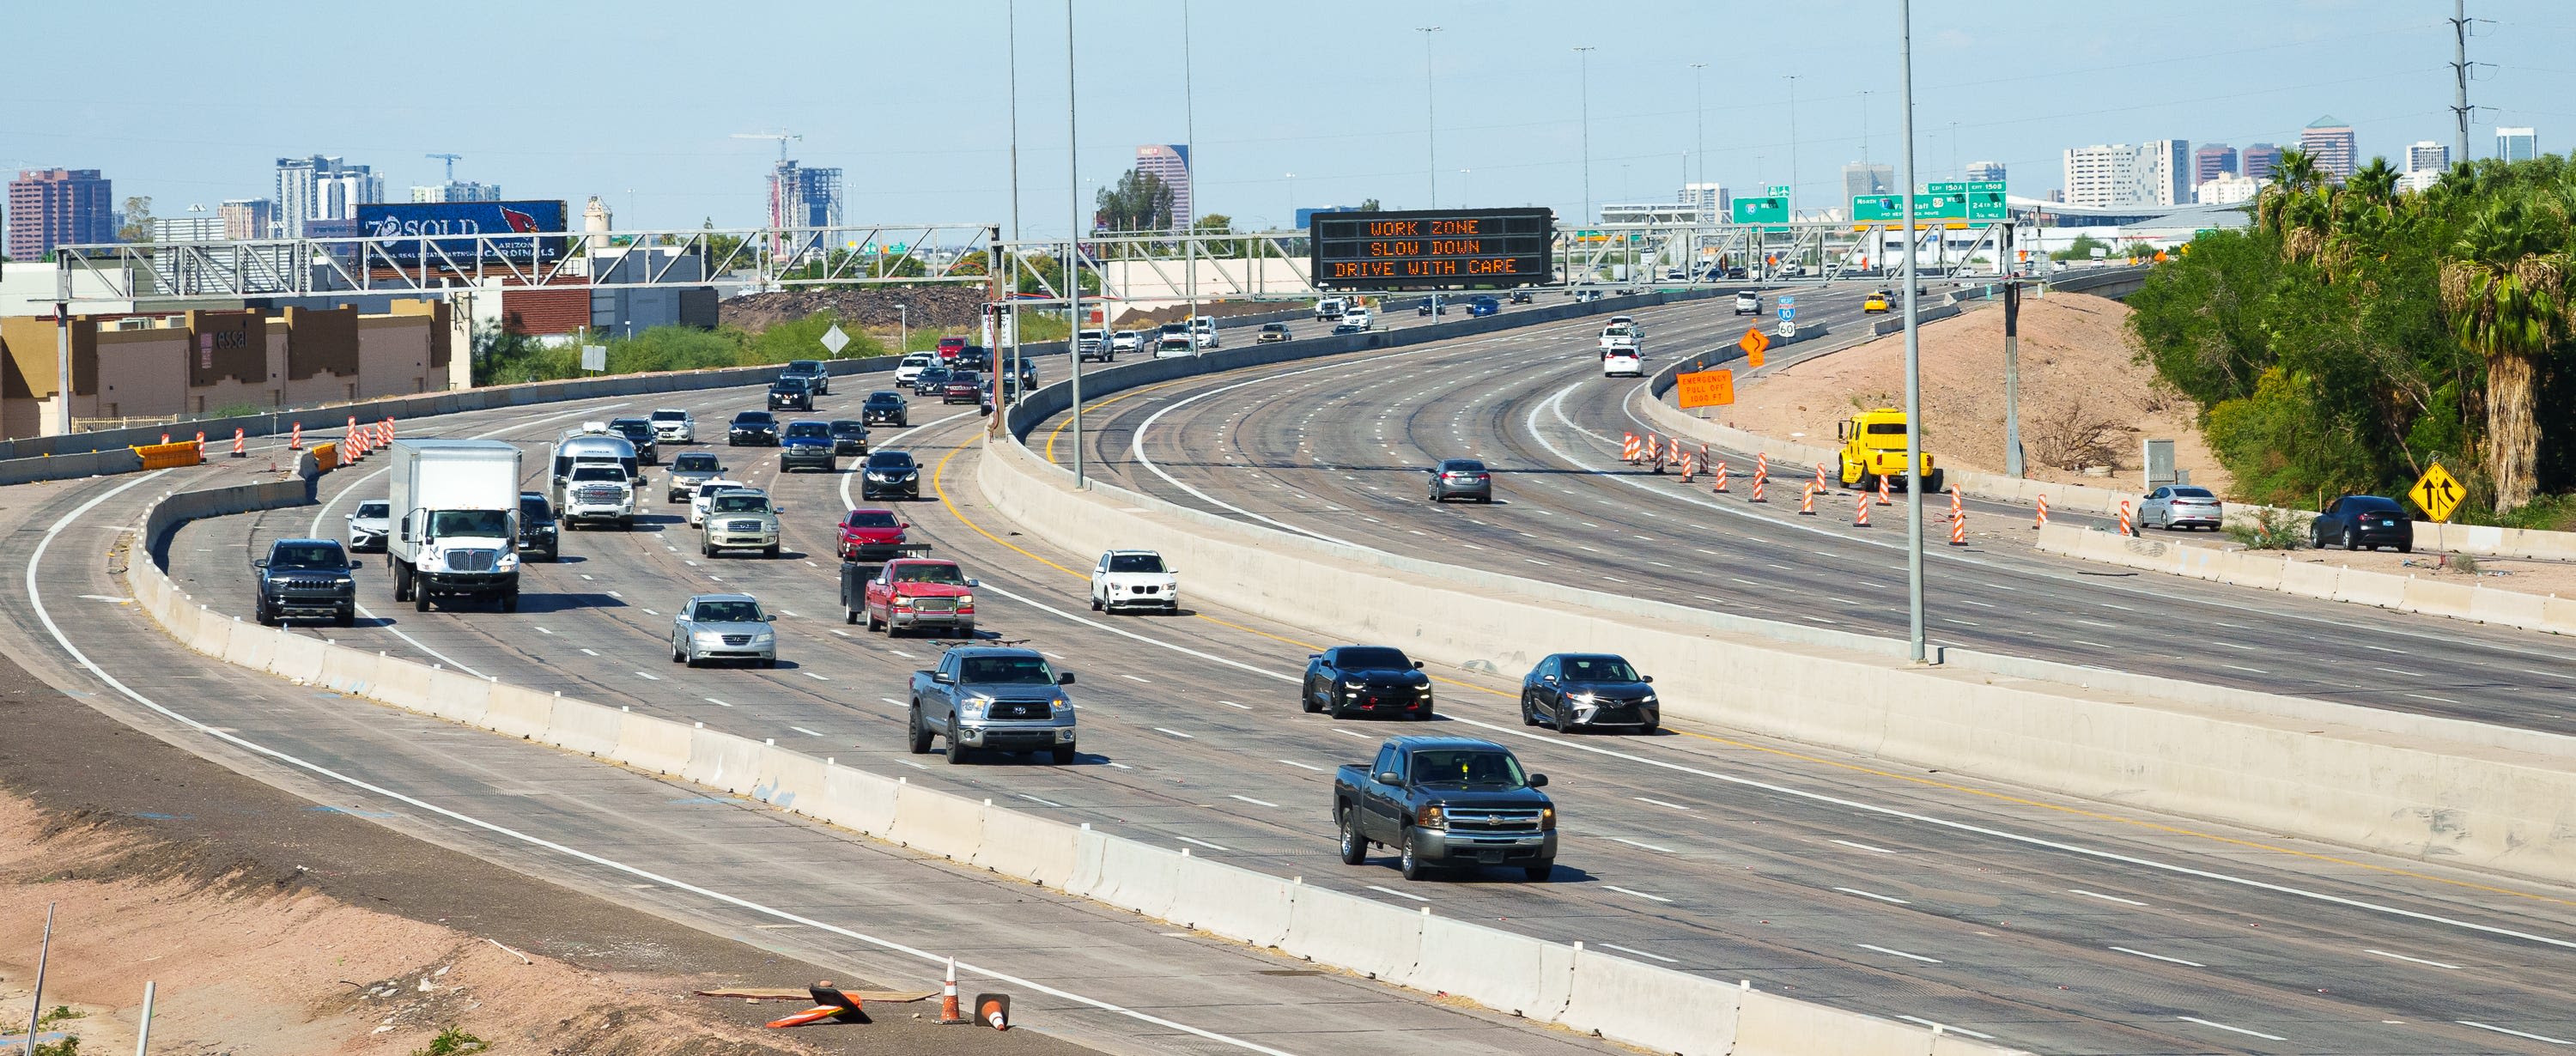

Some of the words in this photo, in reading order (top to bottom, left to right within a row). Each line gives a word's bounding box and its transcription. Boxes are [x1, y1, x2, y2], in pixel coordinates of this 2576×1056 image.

[1370, 221, 1419, 236] WORK
[1431, 219, 1479, 235] ZONE
[483, 246, 555, 258] CRDINLS
[1370, 241, 1419, 257] SLOW
[1431, 240, 1479, 255] DOWN
[1334, 261, 1394, 277] DRIVE
[1407, 260, 1455, 276] WITH
[1468, 258, 1516, 274] CARE
[1782, 310, 1792, 319] 10
[1780, 325, 1794, 334] 60
[1682, 374, 1727, 385] EMERGENCY
[1690, 394, 1709, 403] 1000
[1712, 392, 1722, 401] FT
